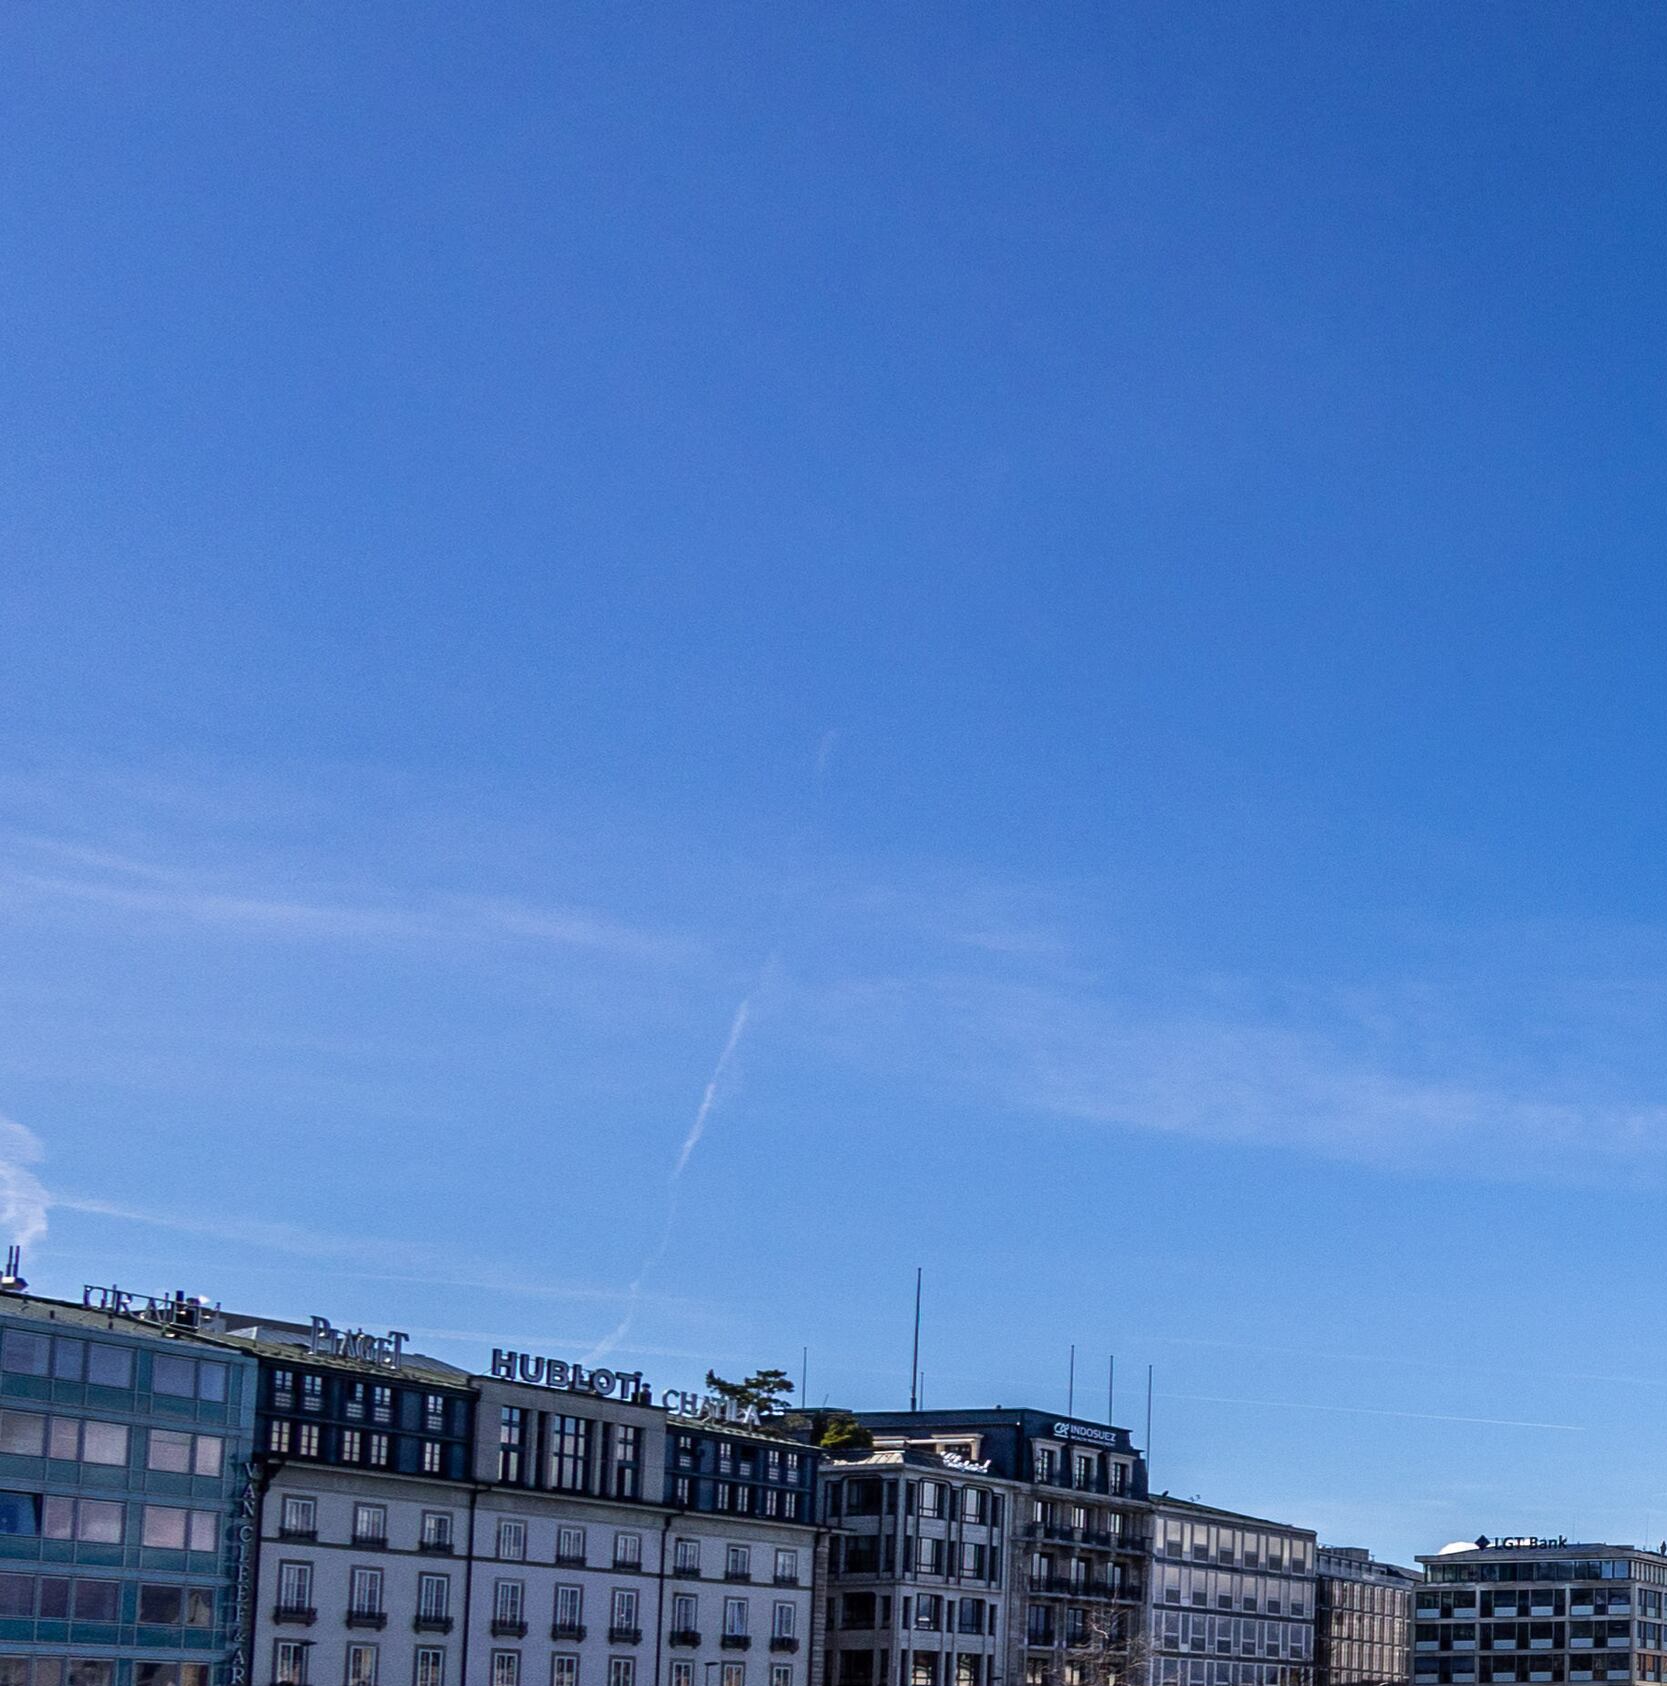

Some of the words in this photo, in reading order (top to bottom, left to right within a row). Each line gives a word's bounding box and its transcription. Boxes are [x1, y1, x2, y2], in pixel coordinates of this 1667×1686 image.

[308, 1315, 410, 1370] PIAGET
[491, 1348, 637, 1400] HUBLOT
[661, 1388, 761, 1425] CHATILA
[1070, 1424, 1117, 1441] INDOSUEZ
[243, 1462, 258, 1518] VAN
[1494, 1536, 1525, 1550] LGT
[1530, 1535, 1567, 1550] Bank
